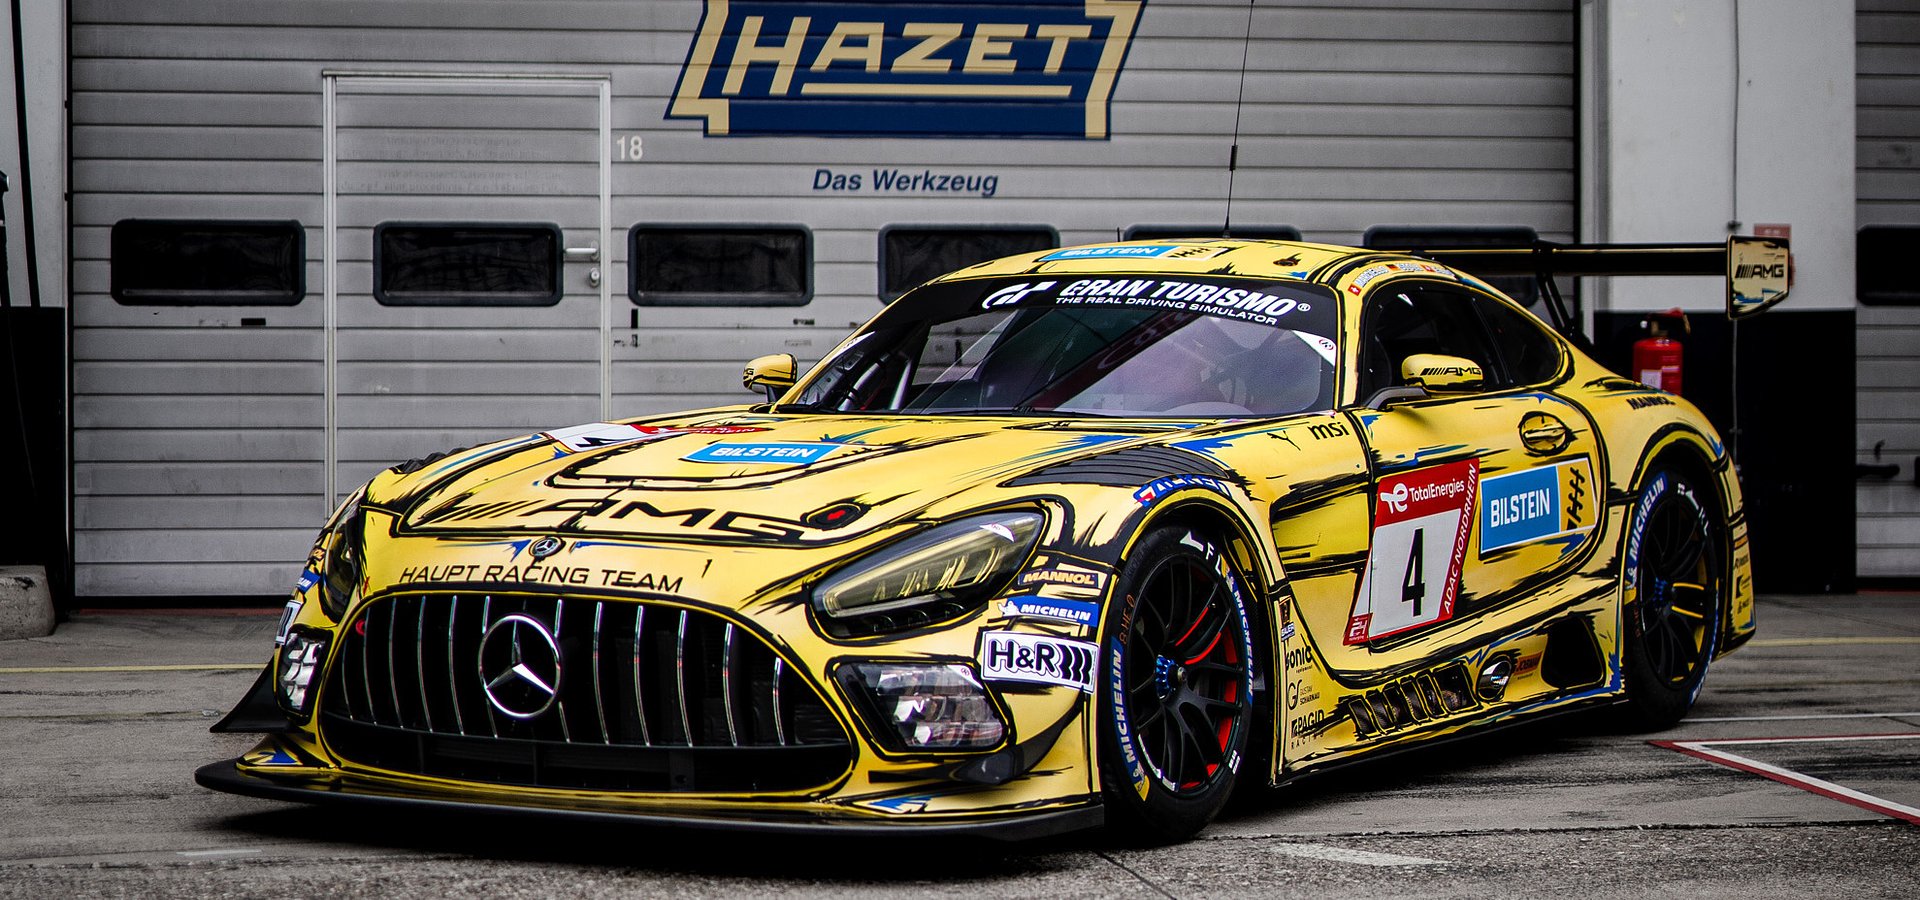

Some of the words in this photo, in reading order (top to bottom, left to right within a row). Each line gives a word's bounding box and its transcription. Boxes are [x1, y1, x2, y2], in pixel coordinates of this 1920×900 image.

[721, 16, 1092, 95] HAZET
[616, 135, 644, 160] 18
[813, 169, 862, 191] Das
[872, 169, 999, 198] Werkzeug
[1060, 247, 1159, 258] BILSTEIN
[1750, 264, 1784, 278] AMG
[1059, 279, 1147, 298] GRAN
[1056, 296, 1086, 306] THE
[1086, 296, 1124, 306] REAL
[1126, 298, 1186, 310] DRIVING
[1189, 303, 1278, 326] SIMULATOR
[1442, 367, 1482, 376] AMG
[1307, 421, 1350, 441] msi
[709, 447, 818, 459] BILSTEIN
[1409, 477, 1465, 503] TotalEnergies
[518, 498, 804, 543] AMG
[1490, 488, 1550, 528] BILSTEIN
[1629, 476, 1665, 558] MICHELIN
[1443, 564, 1459, 614] ADAC
[1454, 463, 1477, 564] NORDRHEIN
[399, 565, 481, 582] HAUPT
[483, 566, 589, 585] RACING
[601, 569, 684, 593] TEAM
[1022, 570, 1095, 586] MANNOL
[1402, 528, 1426, 617] 4
[1020, 604, 1091, 622] MICHELIN
[988, 639, 1057, 674] H&R
[1233, 590, 1253, 697] MICHELIN
[1113, 649, 1137, 764] MICHELIN
